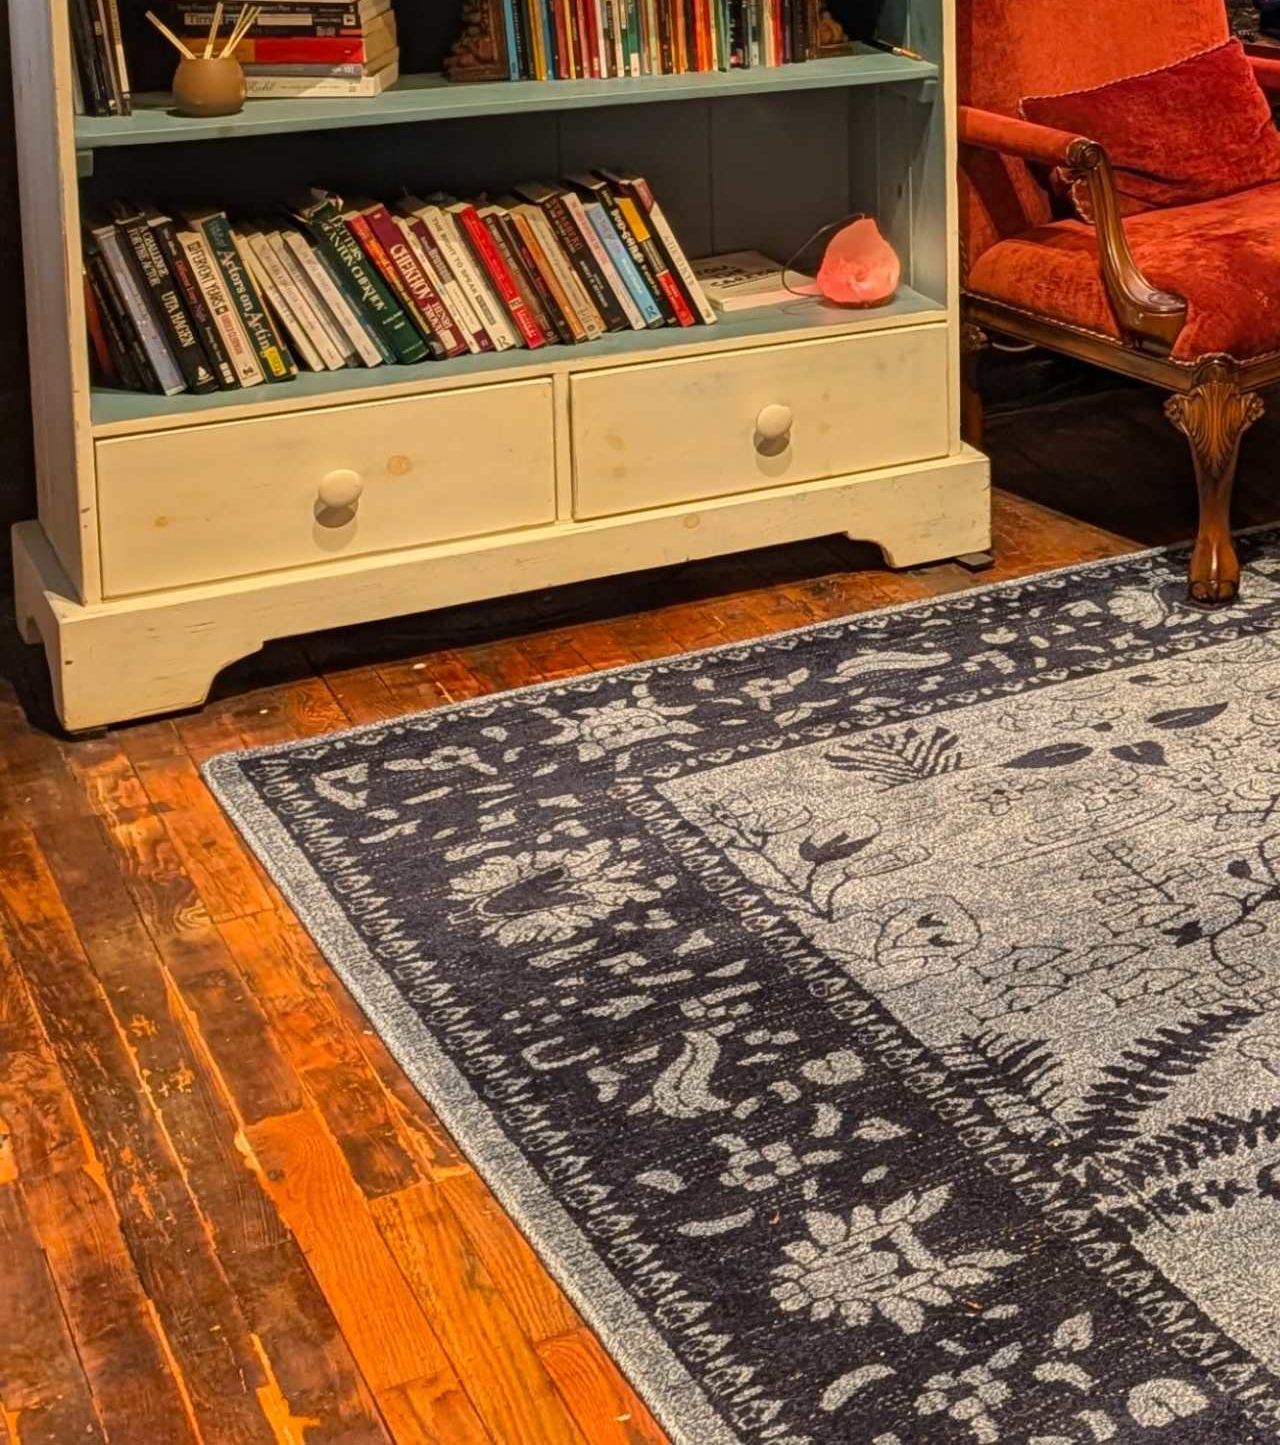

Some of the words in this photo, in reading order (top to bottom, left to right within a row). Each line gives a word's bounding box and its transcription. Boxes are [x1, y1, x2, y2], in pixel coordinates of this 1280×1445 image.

[330, 214, 363, 263] LETTERS
[429, 216, 444, 234] THE
[438, 231, 458, 258] RIGHT
[452, 256, 464, 269] TO
[459, 267, 479, 295] SPEAK
[189, 248, 216, 285] FERVENT
[204, 281, 227, 308] YEARS
[217, 250, 249, 296] Actors
[238, 292, 254, 312] on
[327, 230, 354, 269] ANTON
[351, 266, 387, 312] CHEKHOV
[389, 244, 430, 301] CHEKHOV
[159, 289, 181, 314] UTA
[431, 300, 453, 330] HENRI
[169, 312, 196, 349] HAGEN
